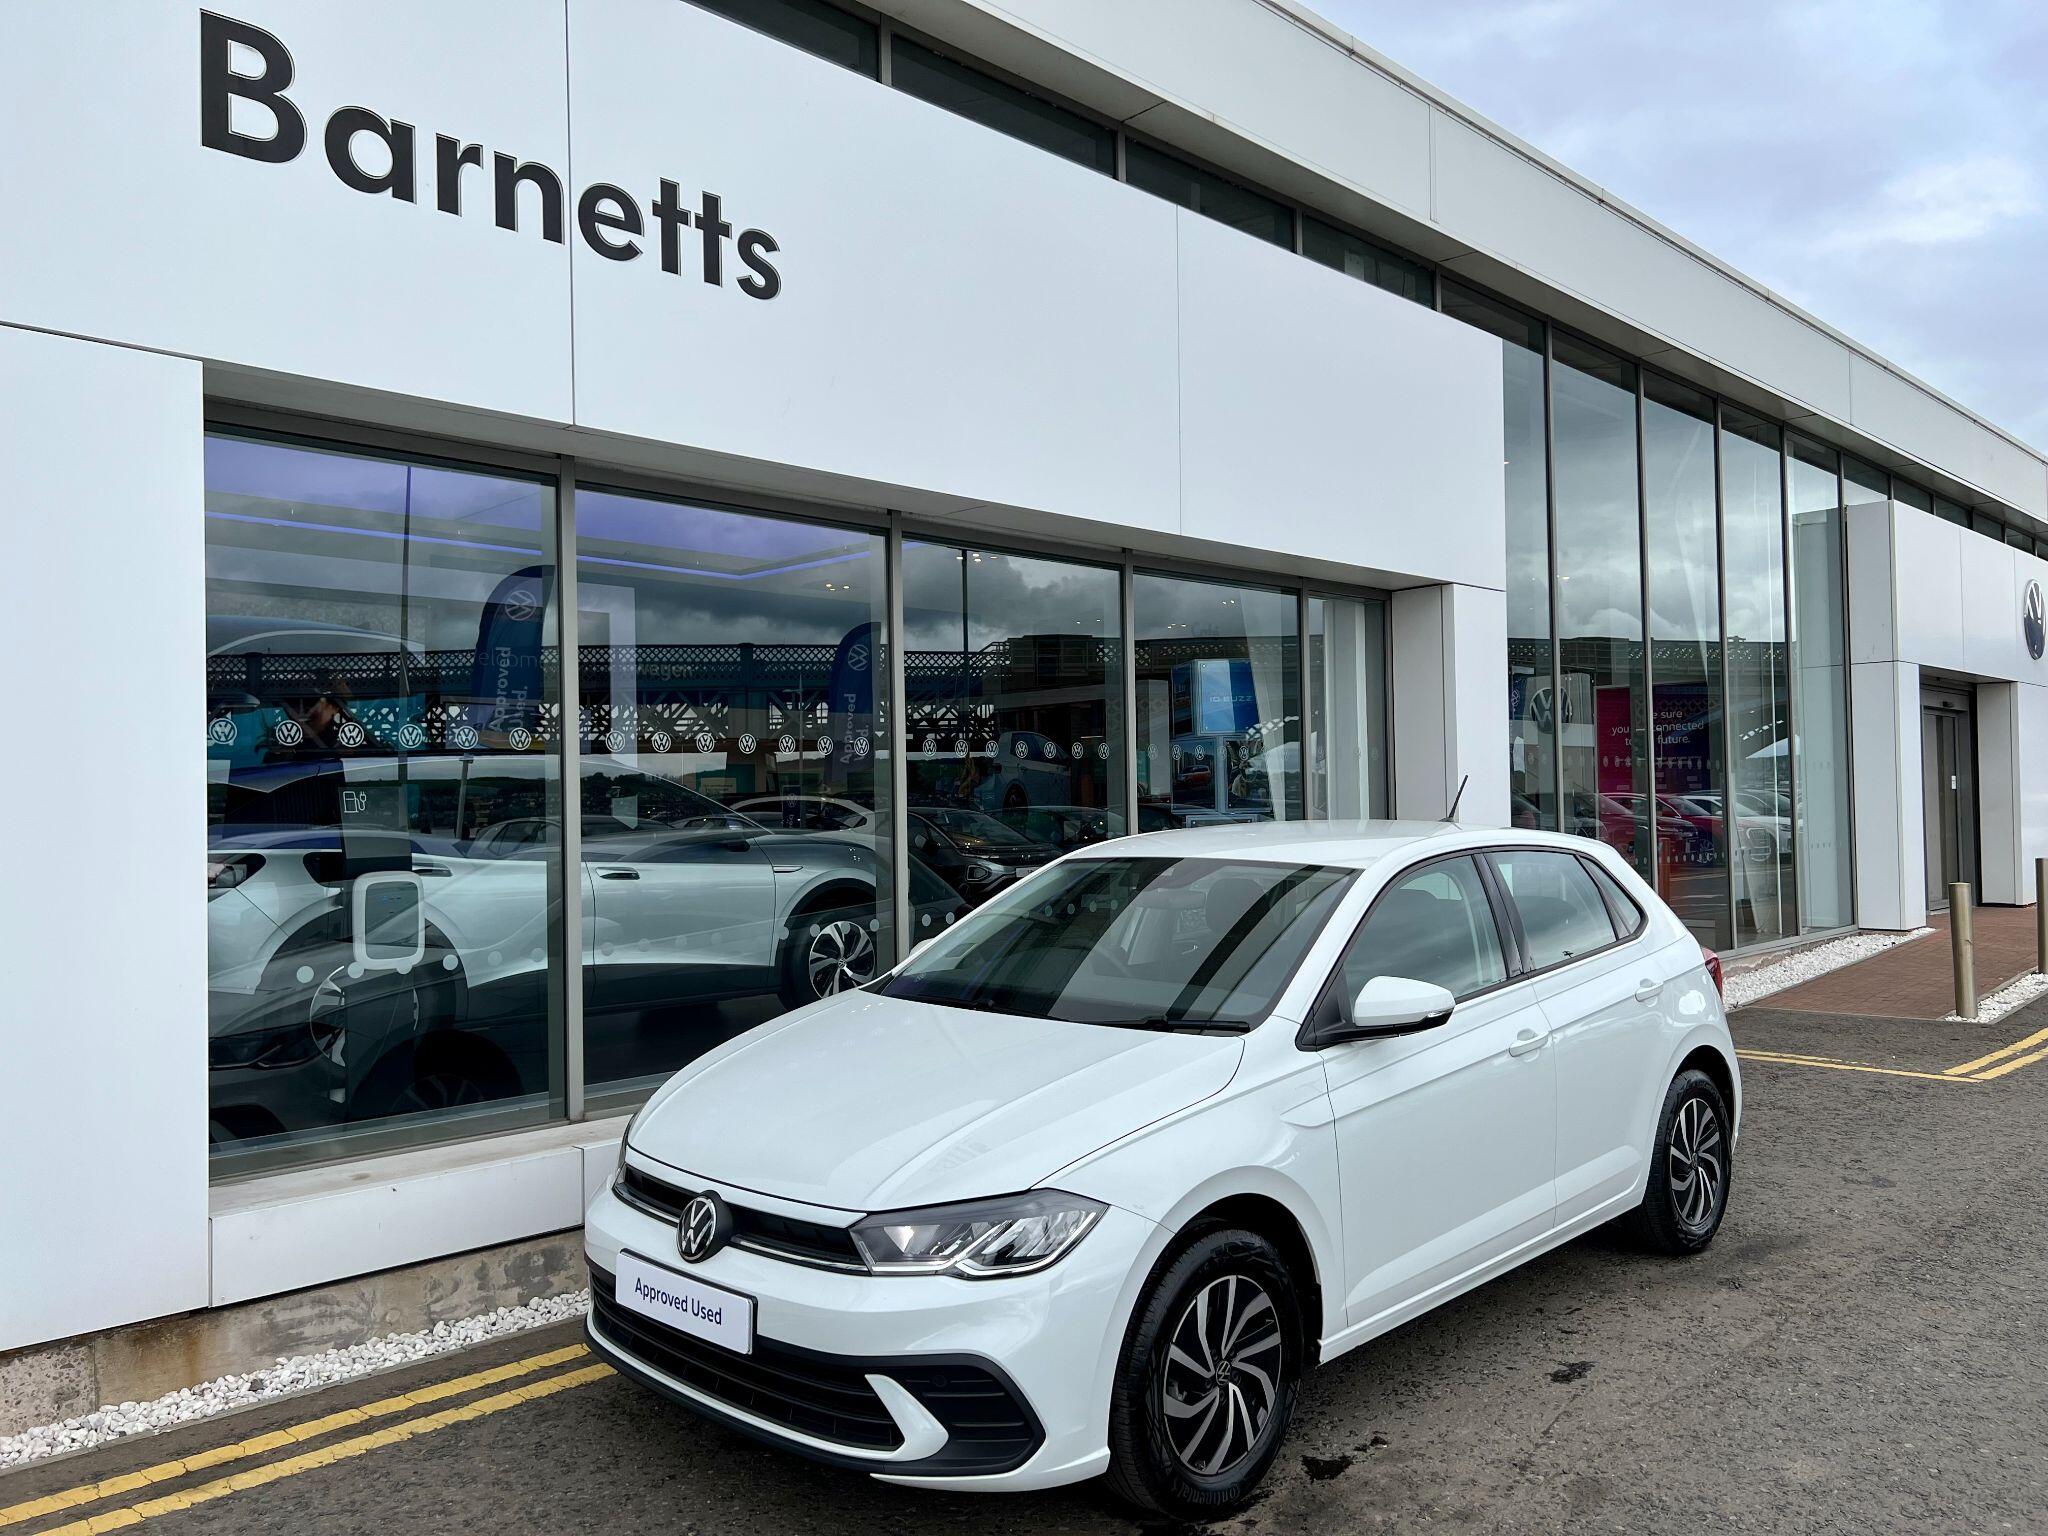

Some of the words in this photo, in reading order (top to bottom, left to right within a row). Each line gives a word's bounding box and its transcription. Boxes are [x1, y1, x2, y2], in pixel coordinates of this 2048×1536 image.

[200, 8, 782, 301] Barnetts
[1660, 710, 1683, 719] sure
[634, 1277, 688, 1313] Approved
[691, 1297, 722, 1326] Used
